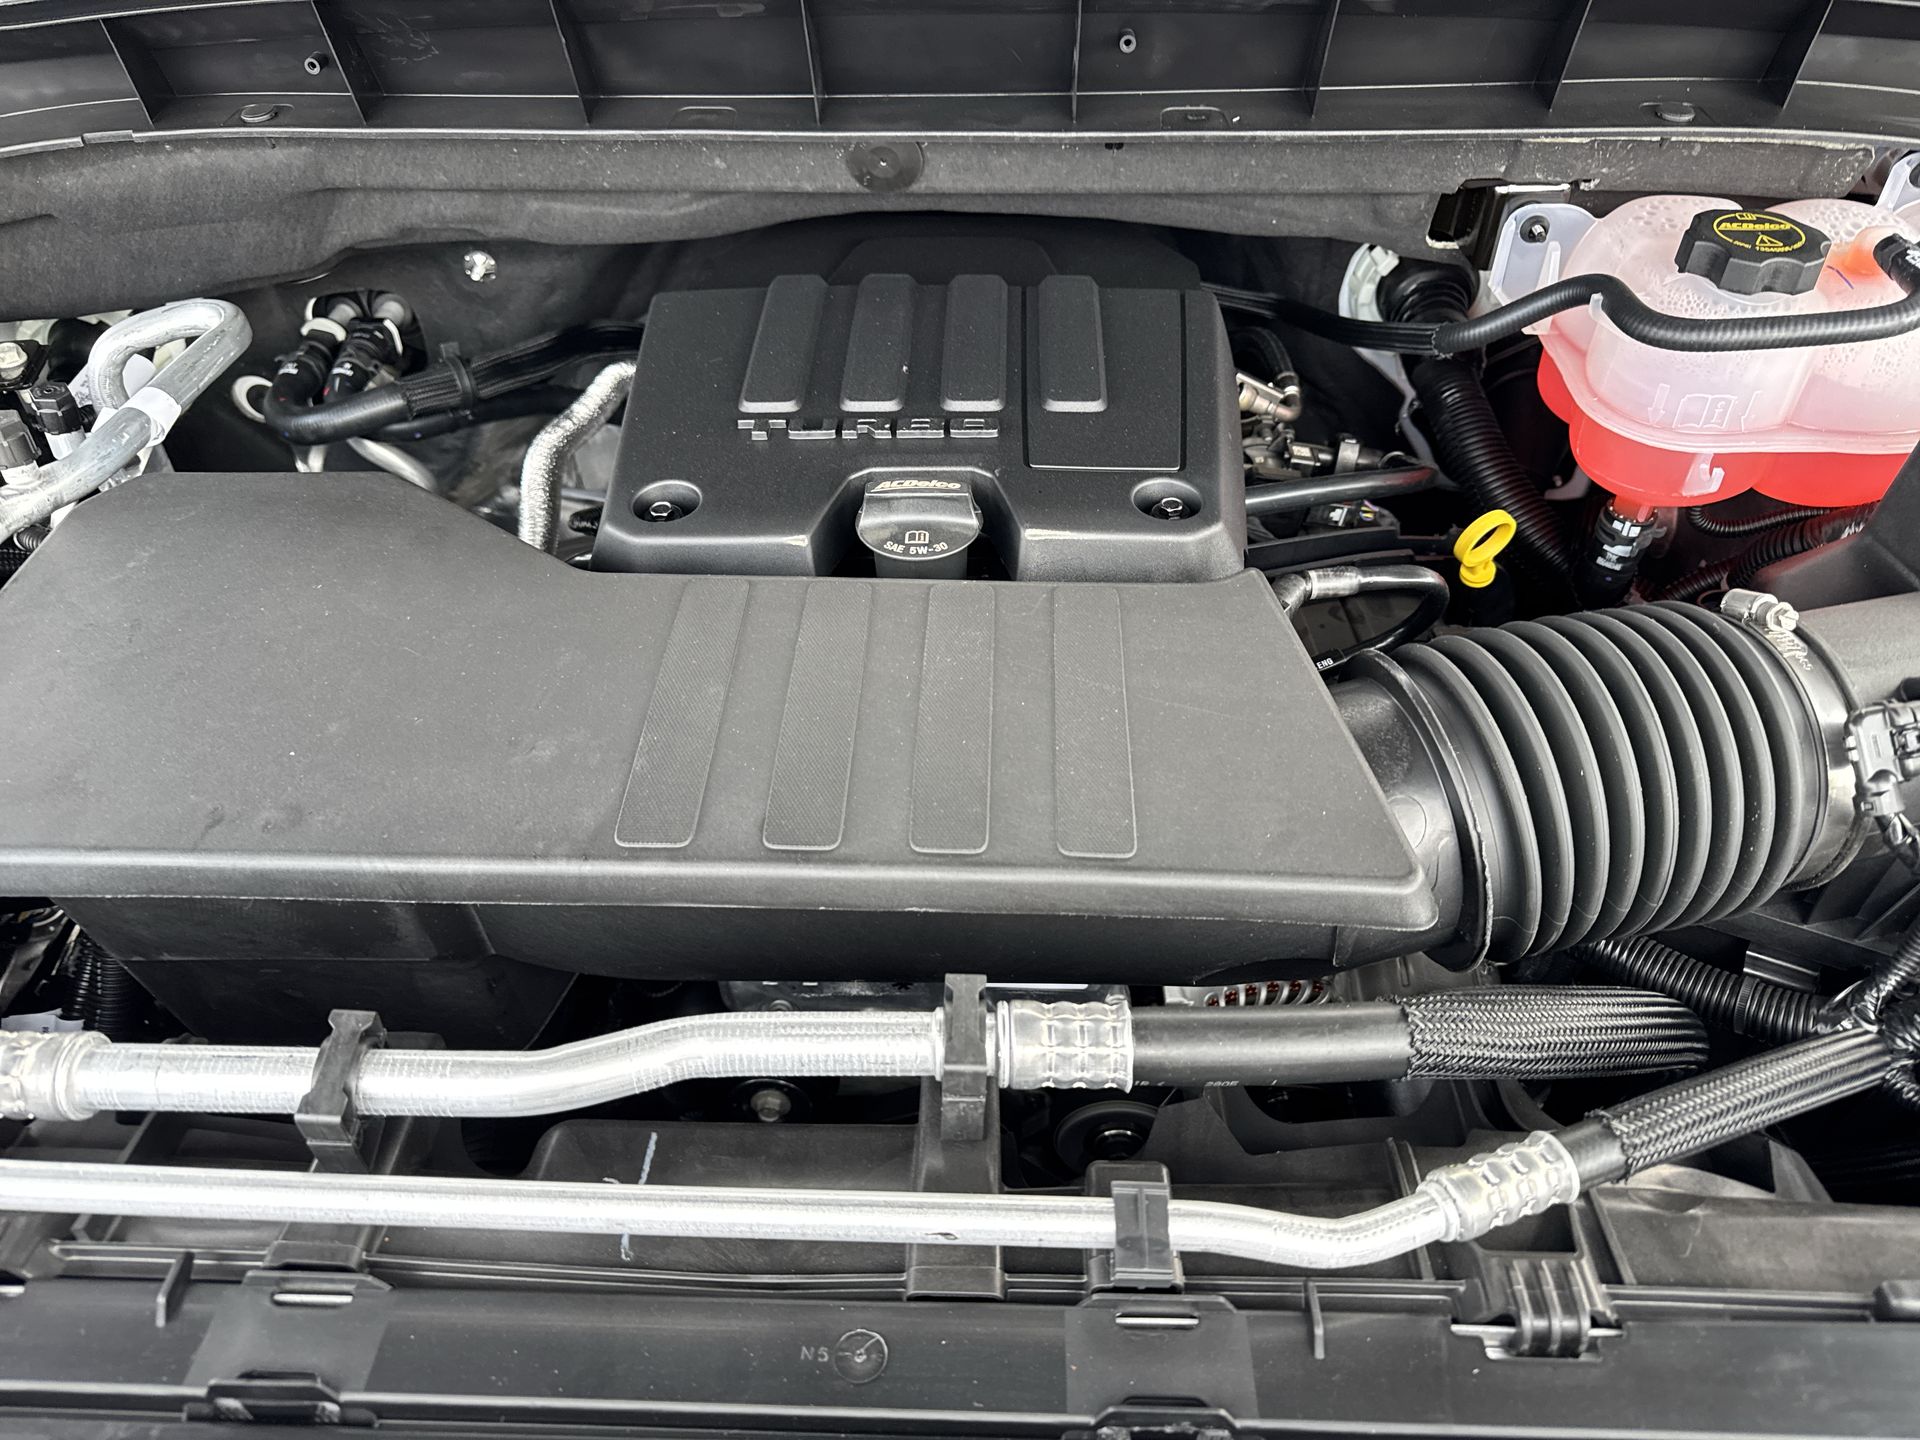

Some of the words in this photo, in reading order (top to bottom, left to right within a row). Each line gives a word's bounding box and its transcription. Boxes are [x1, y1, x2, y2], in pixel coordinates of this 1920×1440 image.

[1717, 221, 1792, 232] ACDelco
[736, 415, 999, 441] TURBO
[871, 479, 962, 493] ACDelco
[883, 541, 906, 553] SAE
[908, 541, 949, 555] 5W-30
